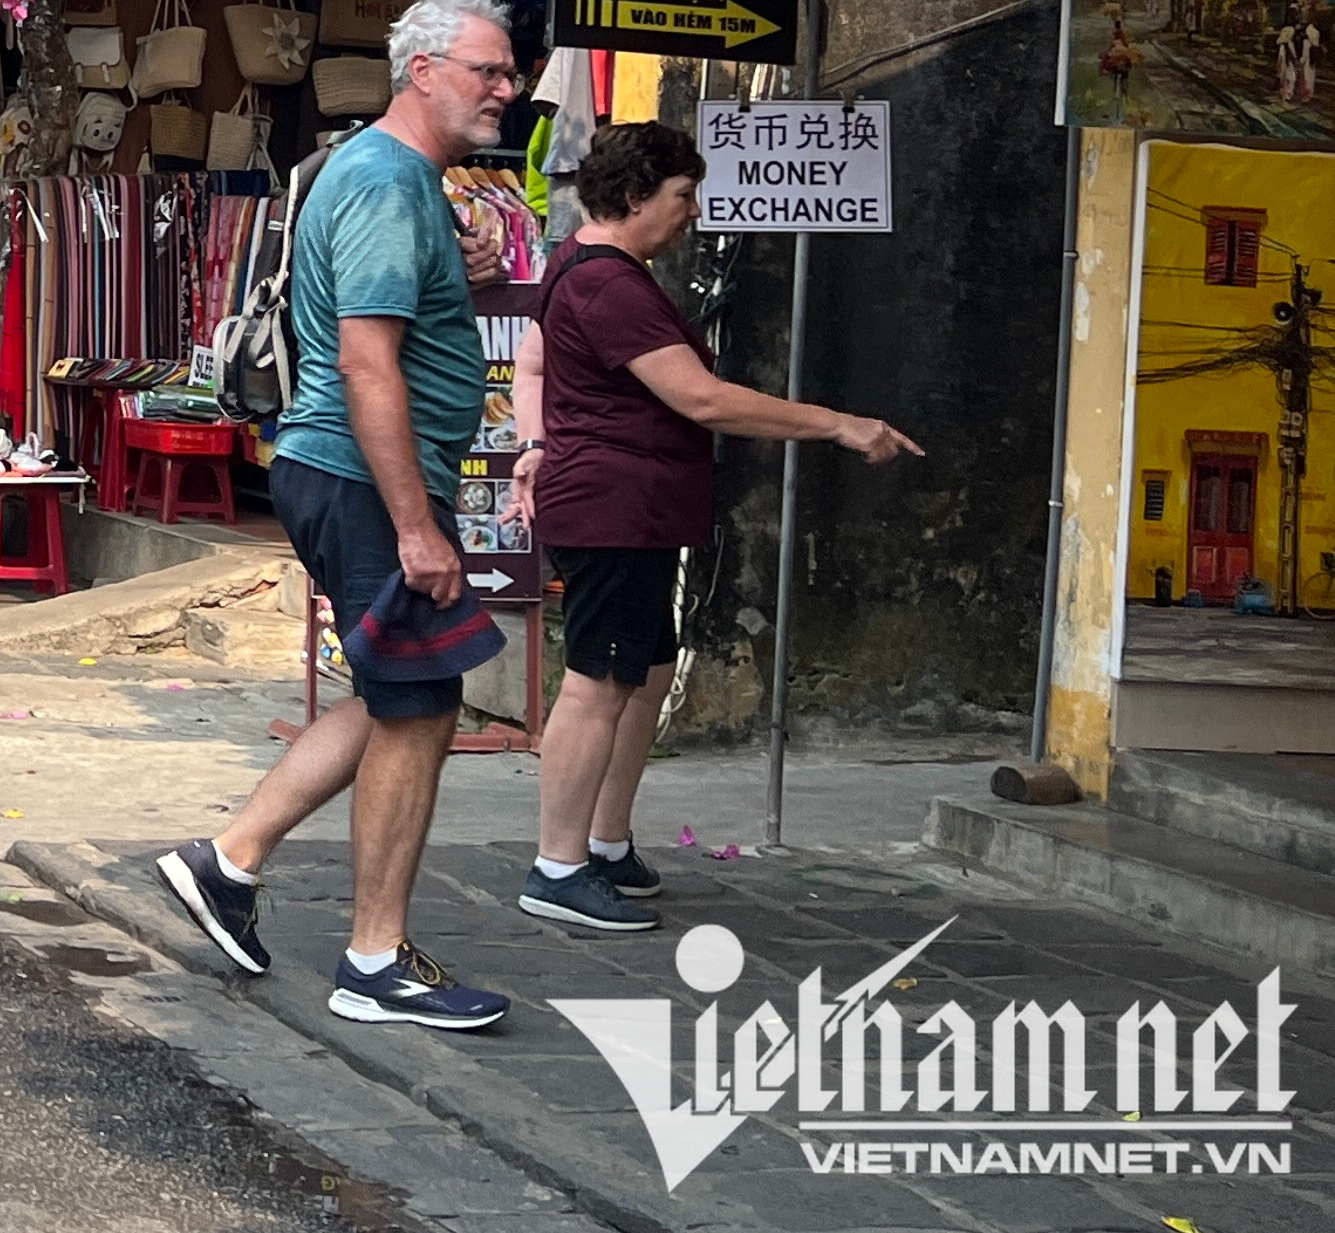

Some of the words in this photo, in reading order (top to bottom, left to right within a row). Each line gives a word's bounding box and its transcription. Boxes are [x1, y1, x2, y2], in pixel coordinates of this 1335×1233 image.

[631, 9, 667, 27] VÀO
[719, 17, 756, 33] 15M
[708, 112, 879, 150] 货币兑换
[738, 161, 848, 186] MONEY
[708, 197, 879, 223] EXCHANGE
